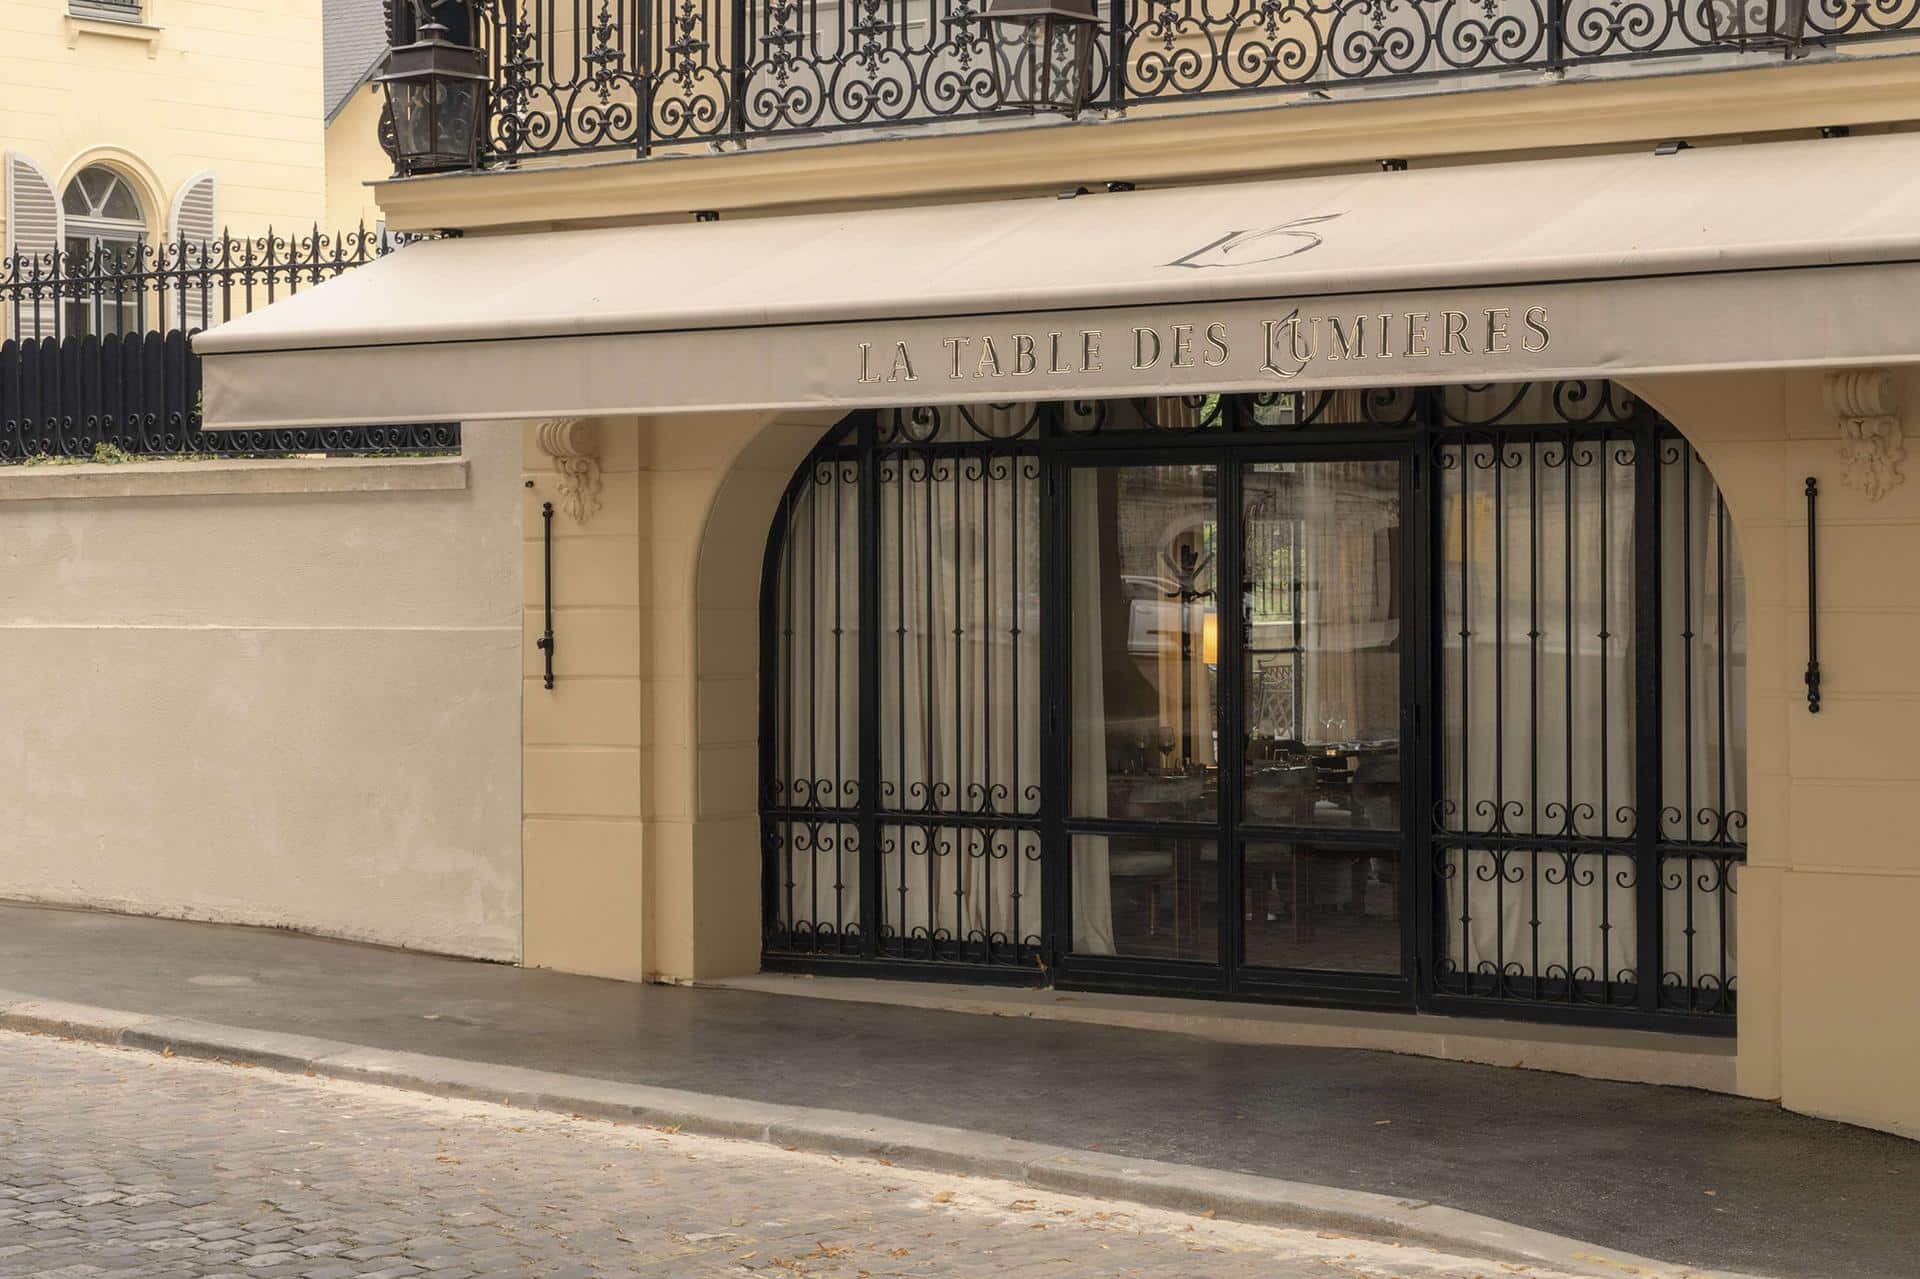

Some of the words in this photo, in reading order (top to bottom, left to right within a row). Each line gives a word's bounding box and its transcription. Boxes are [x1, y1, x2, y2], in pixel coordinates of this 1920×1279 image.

[858, 341, 918, 384] LA
[943, 329, 1104, 380] TABLE
[1130, 321, 1230, 371] DES
[1259, 306, 1551, 378] LUMIERES
